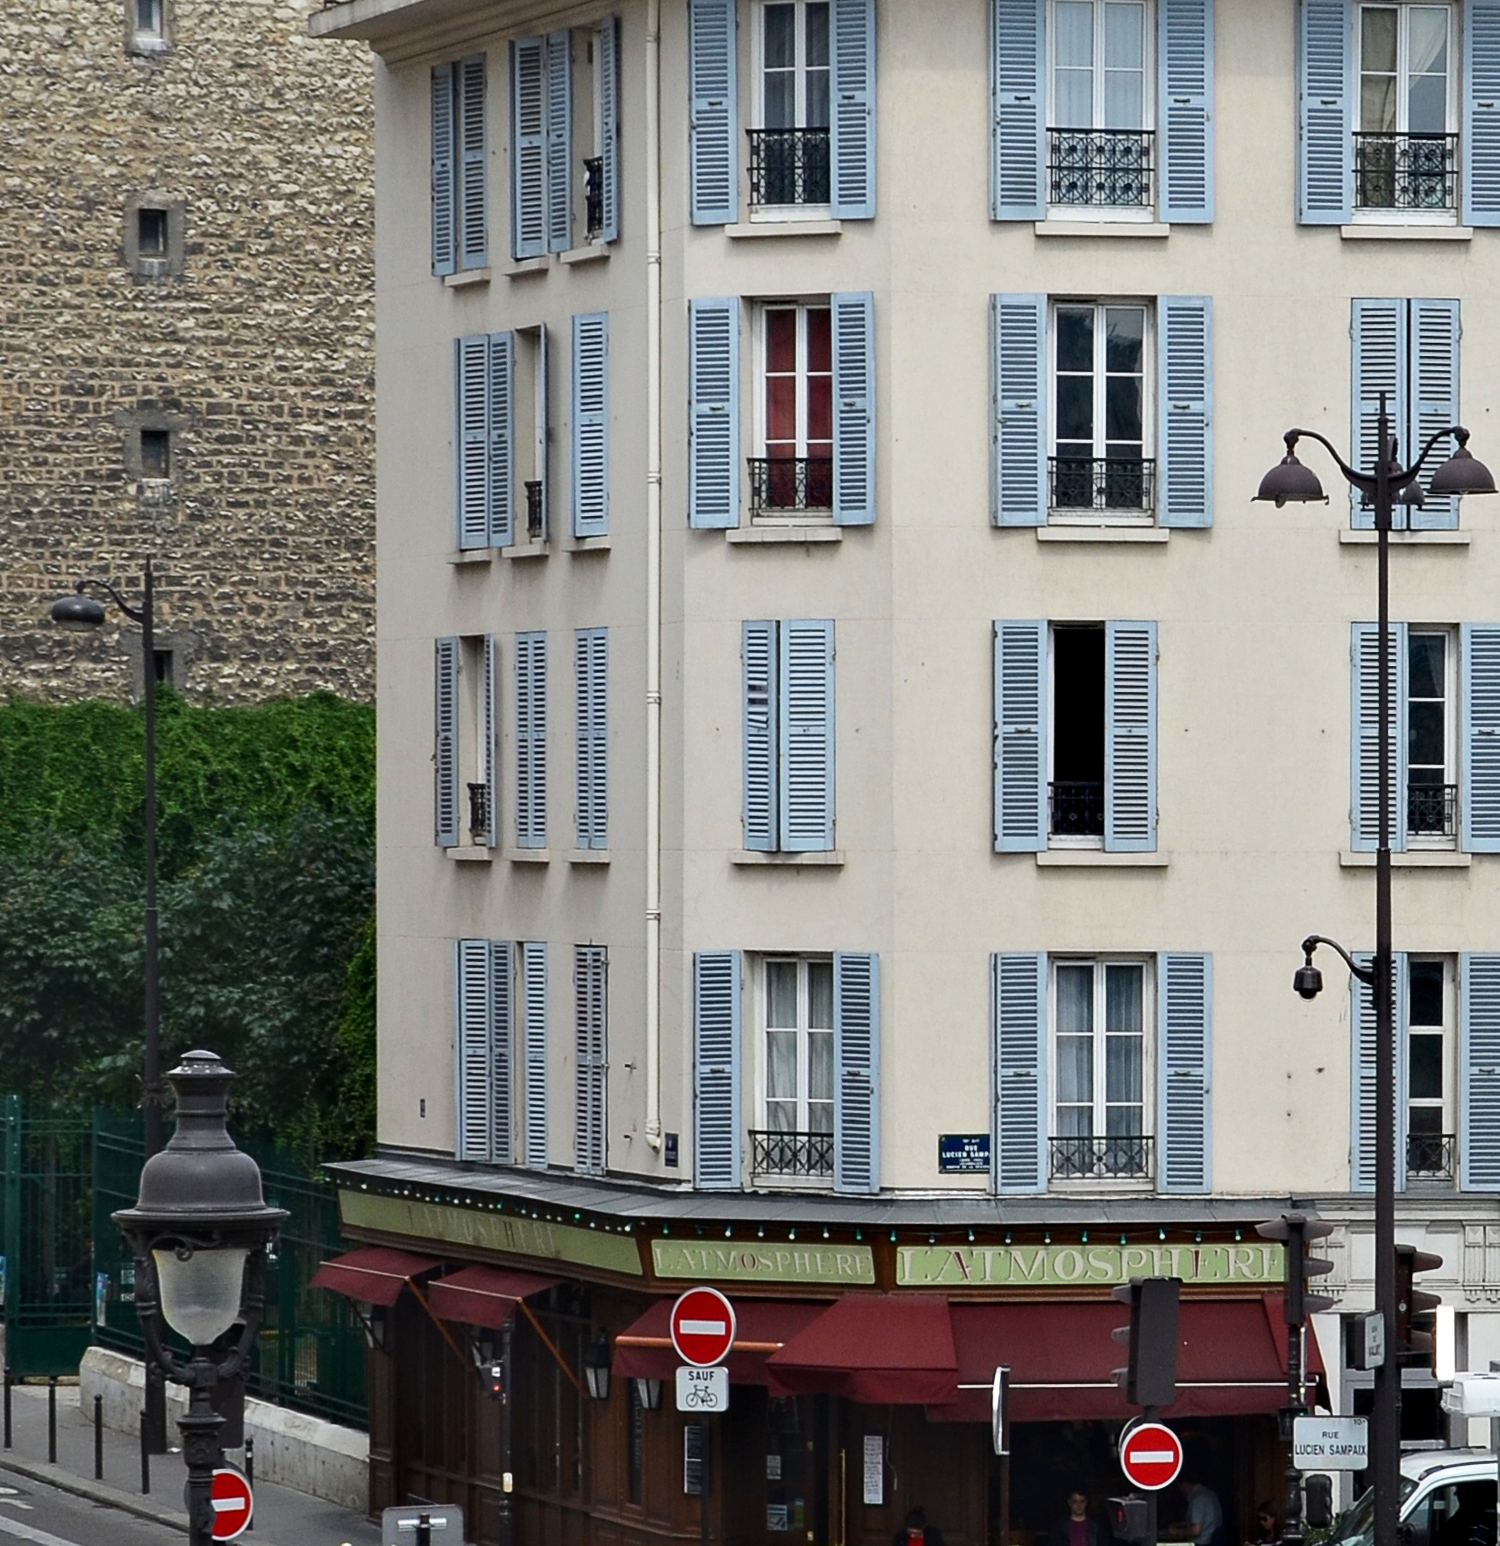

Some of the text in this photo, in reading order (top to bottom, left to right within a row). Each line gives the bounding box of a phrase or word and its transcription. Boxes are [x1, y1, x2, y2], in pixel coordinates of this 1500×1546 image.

[688, 1370, 715, 1382] SAUF
[1321, 1430, 1340, 1440] RUE
[1295, 1444, 1367, 1456] LUCIEN SAMPAIX
